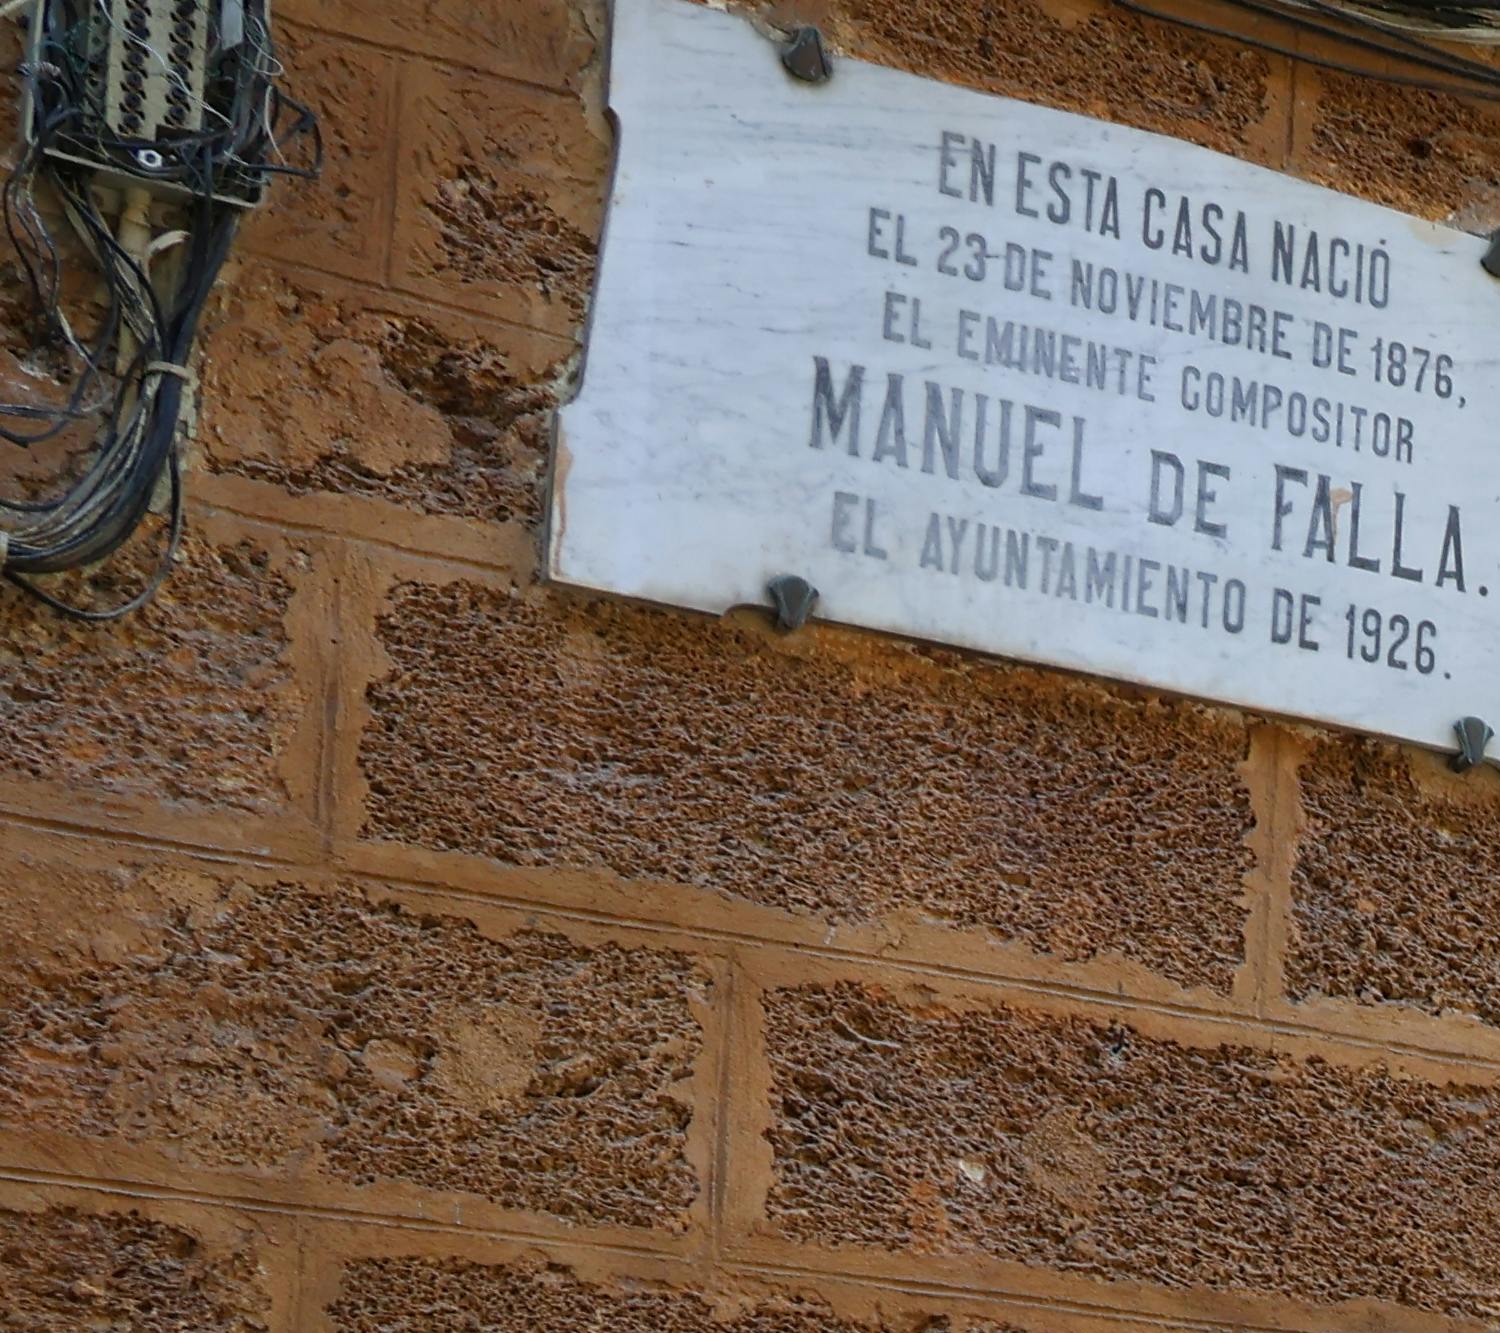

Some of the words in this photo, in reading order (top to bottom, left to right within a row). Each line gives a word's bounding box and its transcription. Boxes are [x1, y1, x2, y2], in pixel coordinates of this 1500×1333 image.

[866, 206, 918, 267] EL
[937, 226, 987, 282] 23
[1004, 241, 1054, 300] DE
[1070, 258, 1294, 360] NOVIEMBRE
[1311, 320, 1358, 376] DE
[1369, 336, 1466, 409] 1876,
[937, 130, 996, 206] EN
[1014, 150, 1120, 240] ESTA
[1141, 186, 1249, 274] CASA
[1270, 219, 1390, 309] NACIÓ
[882, 290, 931, 350] EL
[956, 308, 1157, 402] EMINENTE
[1180, 364, 1414, 464] COMPOSITOR
[808, 355, 1103, 511] MANUEL
[1146, 448, 1230, 539] DE
[1271, 462, 1488, 597] FALLA.
[831, 490, 886, 560] EL
[919, 512, 1246, 634] AYUNTAMIENTO
[1270, 587, 1321, 652] DE
[1344, 603, 1451, 680] 1926.
